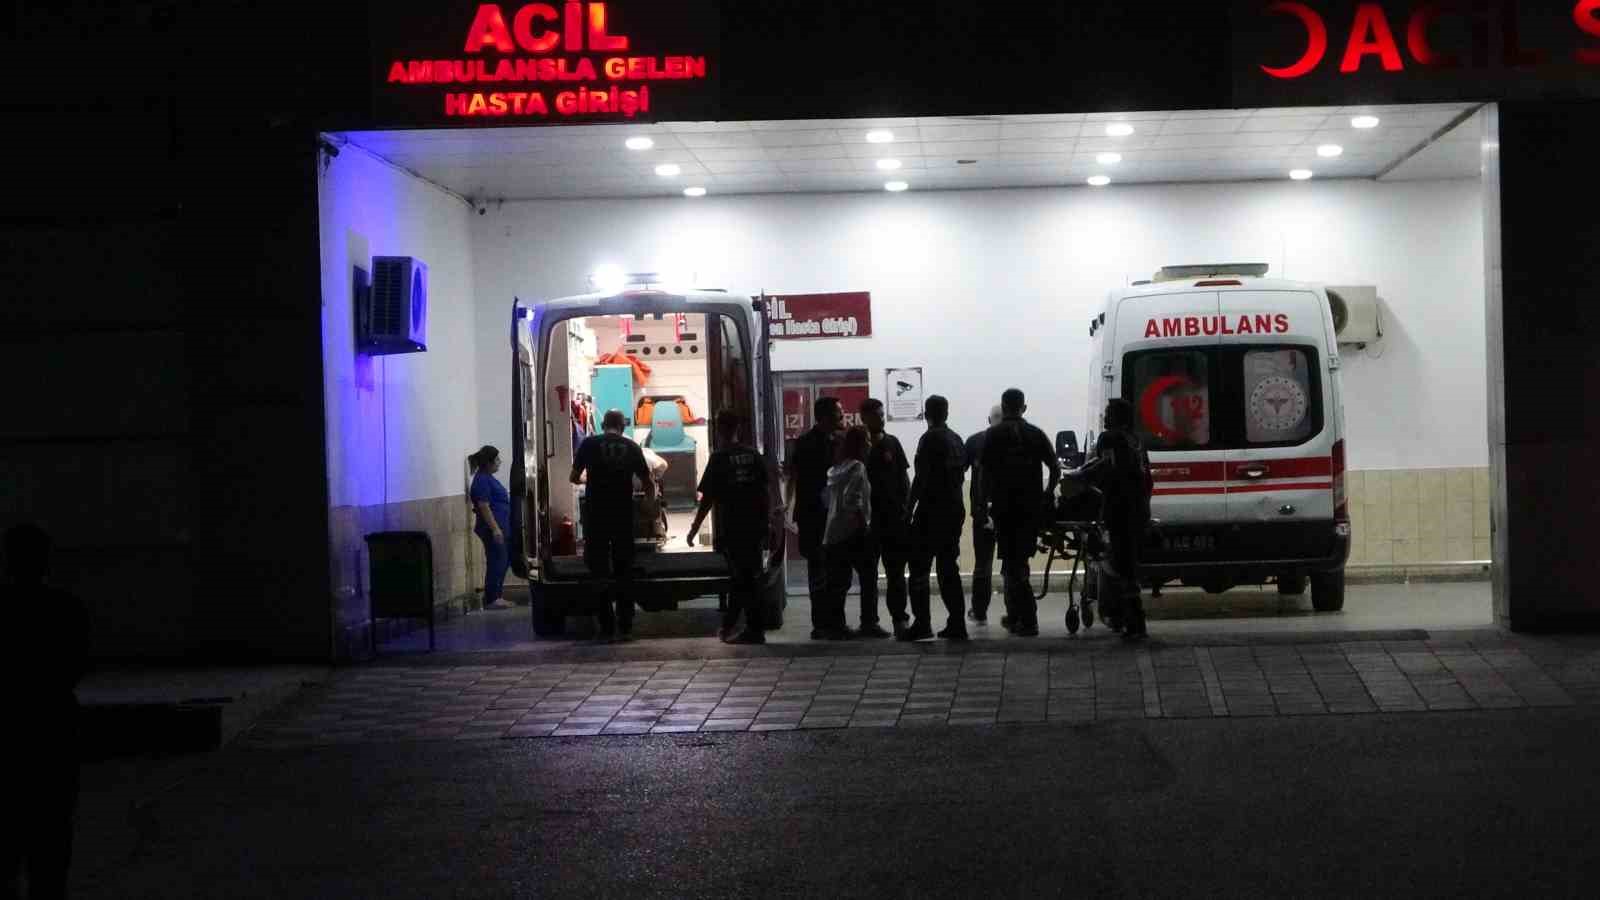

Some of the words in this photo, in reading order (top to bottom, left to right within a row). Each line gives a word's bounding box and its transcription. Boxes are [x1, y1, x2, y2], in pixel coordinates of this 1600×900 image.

[464, 0, 628, 53] ACİL
[387, 58, 597, 82] AMBULANSLA
[605, 56, 705, 79] GELEN
[445, 92, 548, 116] HASTA
[555, 85, 649, 118] GİRİŞİ
[1144, 314, 1290, 338] AMBULANS
